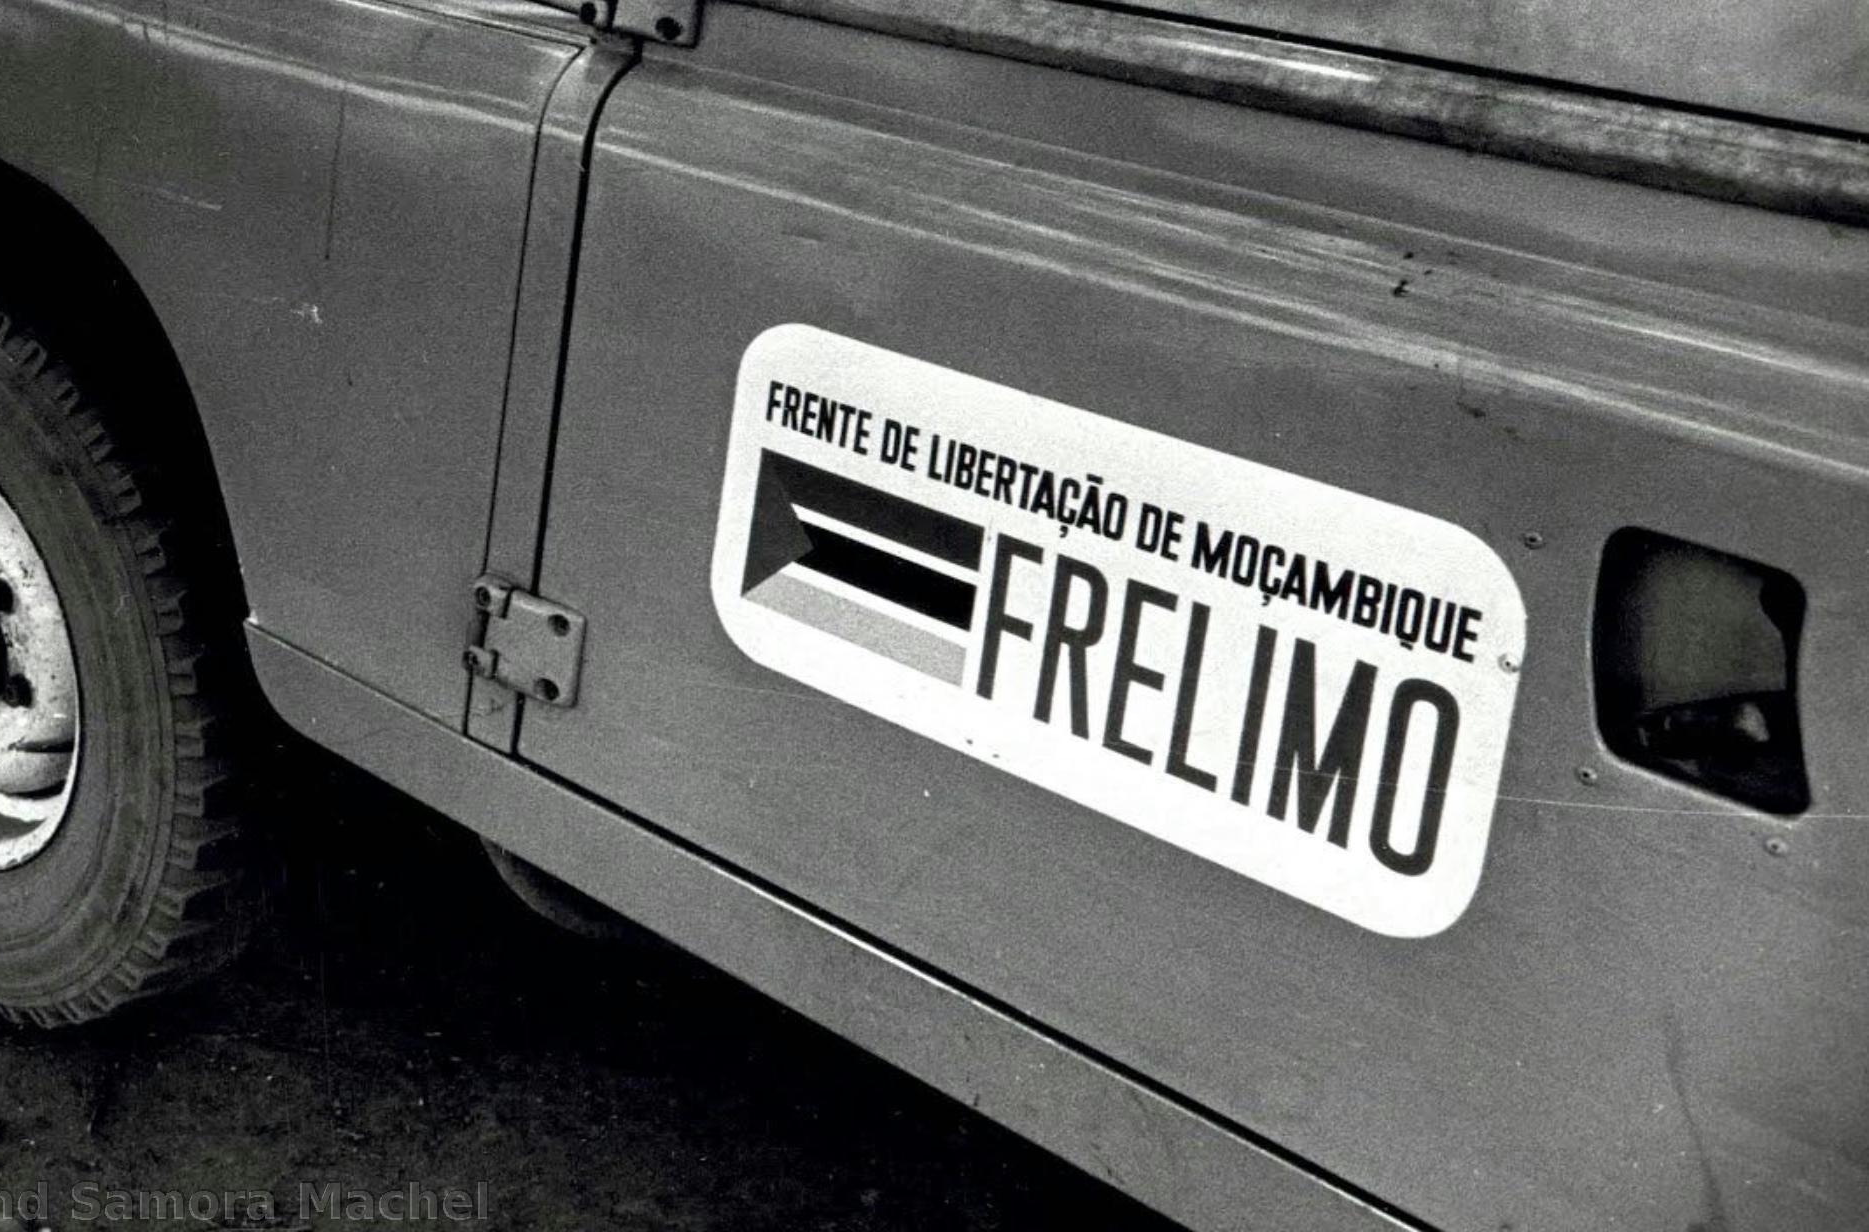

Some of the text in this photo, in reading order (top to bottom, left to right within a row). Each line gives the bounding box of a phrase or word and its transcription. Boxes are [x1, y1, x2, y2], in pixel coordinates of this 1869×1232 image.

[766, 380, 1483, 663] FRENTE DE LIBERTAÇÃO DE MOÇAMBIQUE
[976, 532, 1460, 877] FRELIMO
